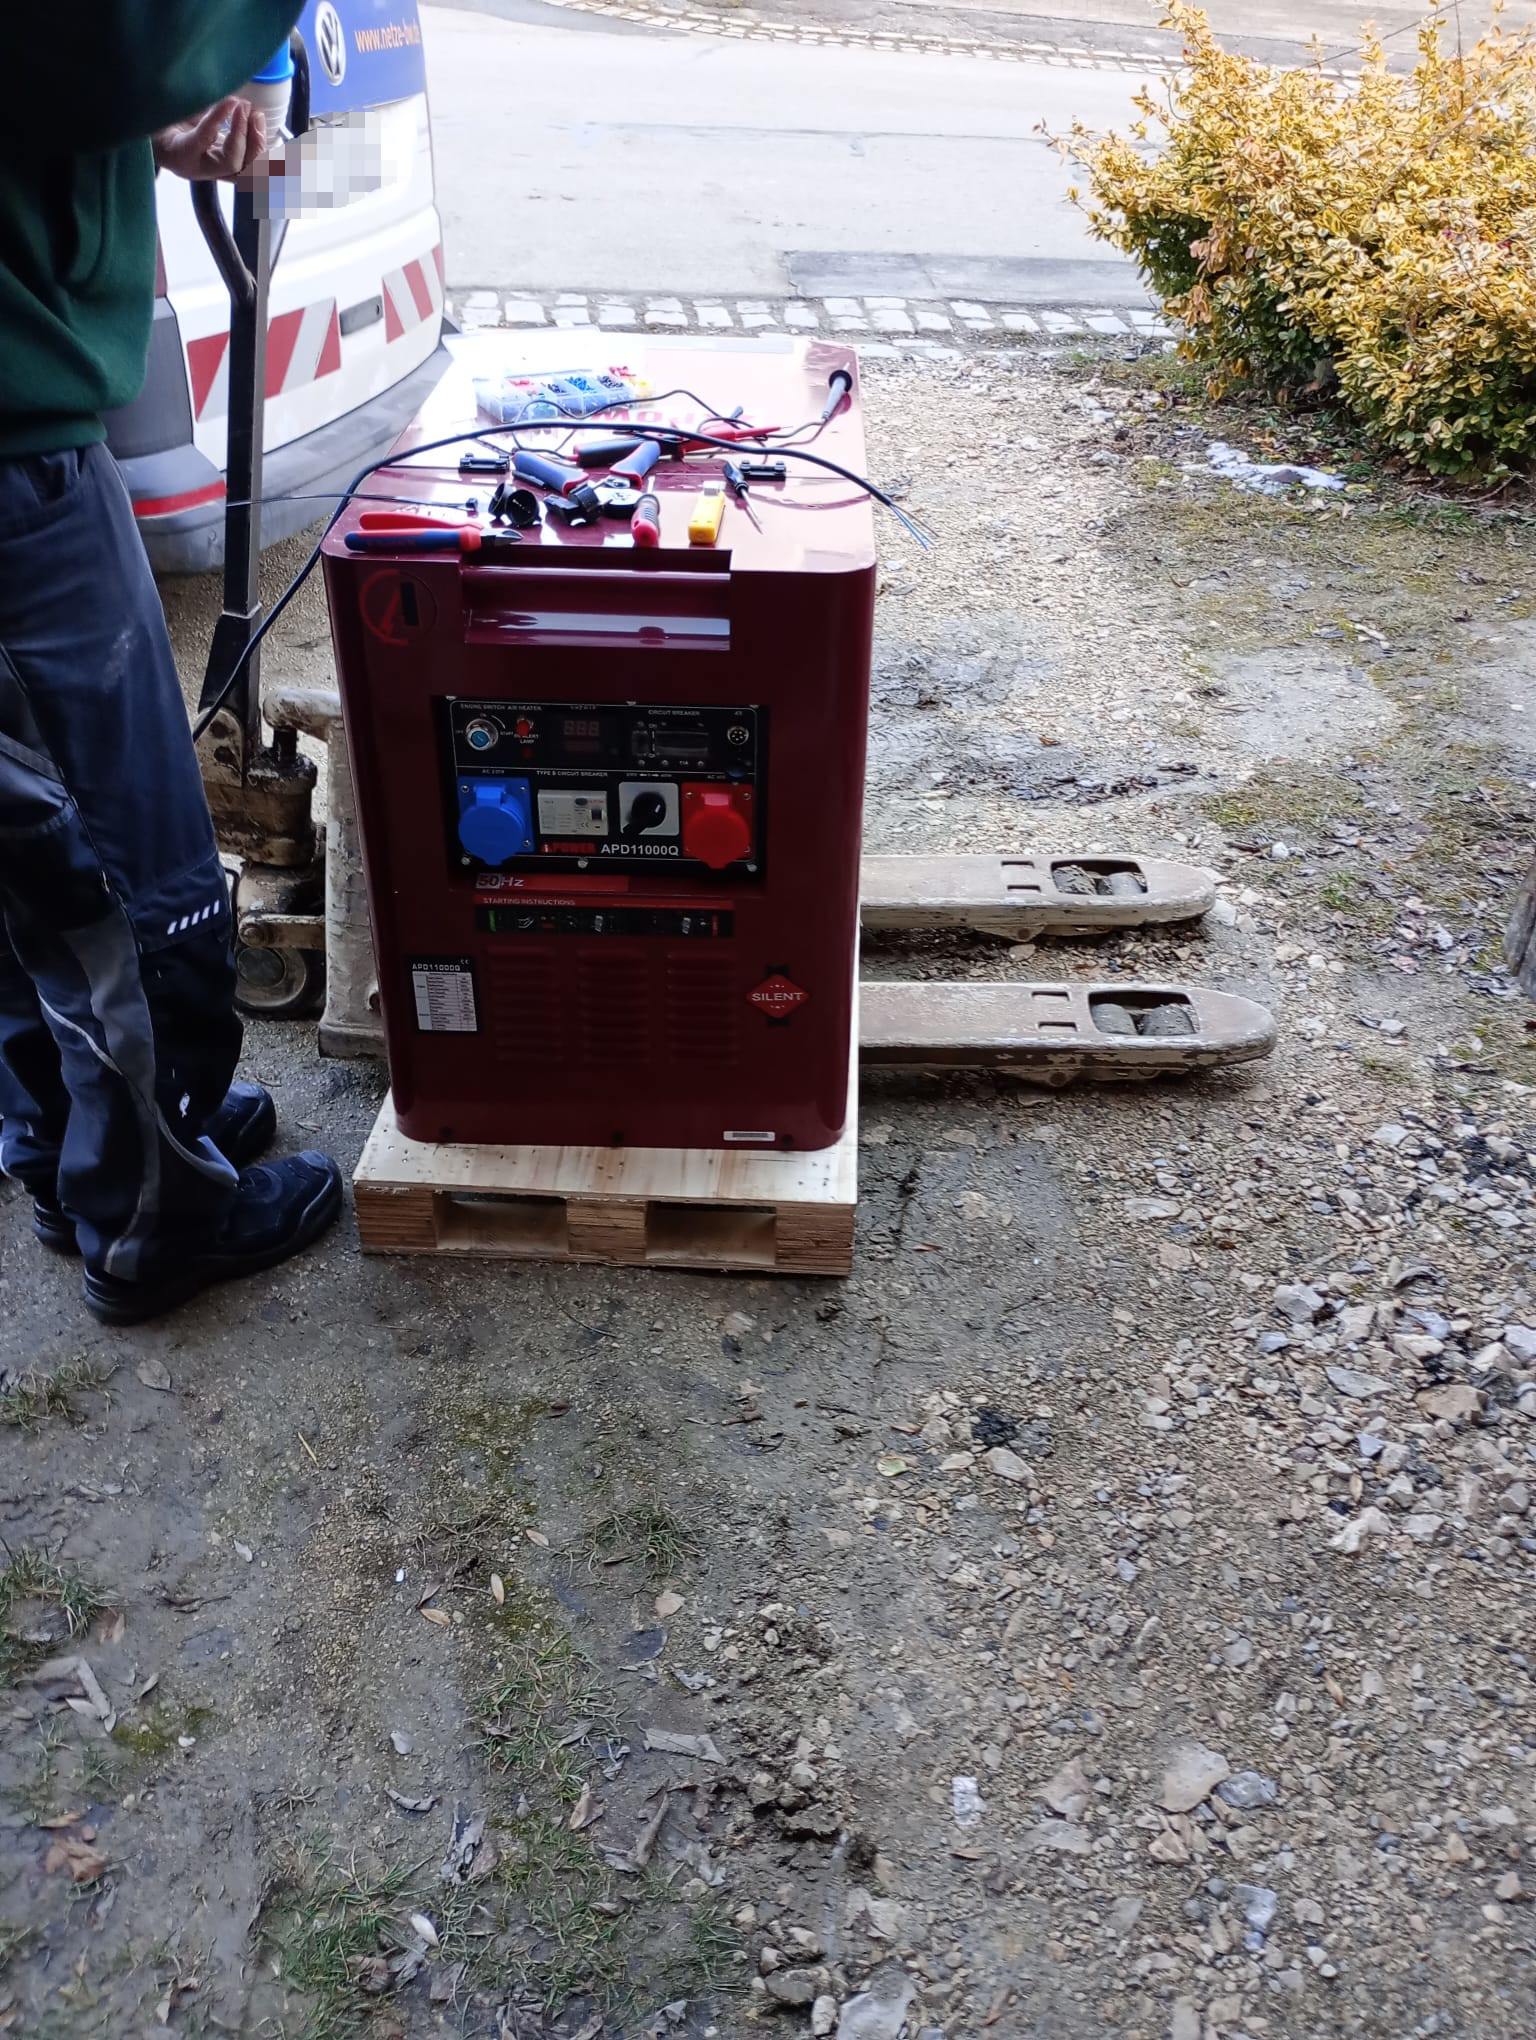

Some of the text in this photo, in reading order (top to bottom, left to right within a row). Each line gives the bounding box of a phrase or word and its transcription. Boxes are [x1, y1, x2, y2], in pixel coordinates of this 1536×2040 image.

[600, 843, 679, 857] APD11000Q
[483, 896, 576, 907] STARTING INSTRUCTIONS
[751, 992, 805, 1001] SILENT
